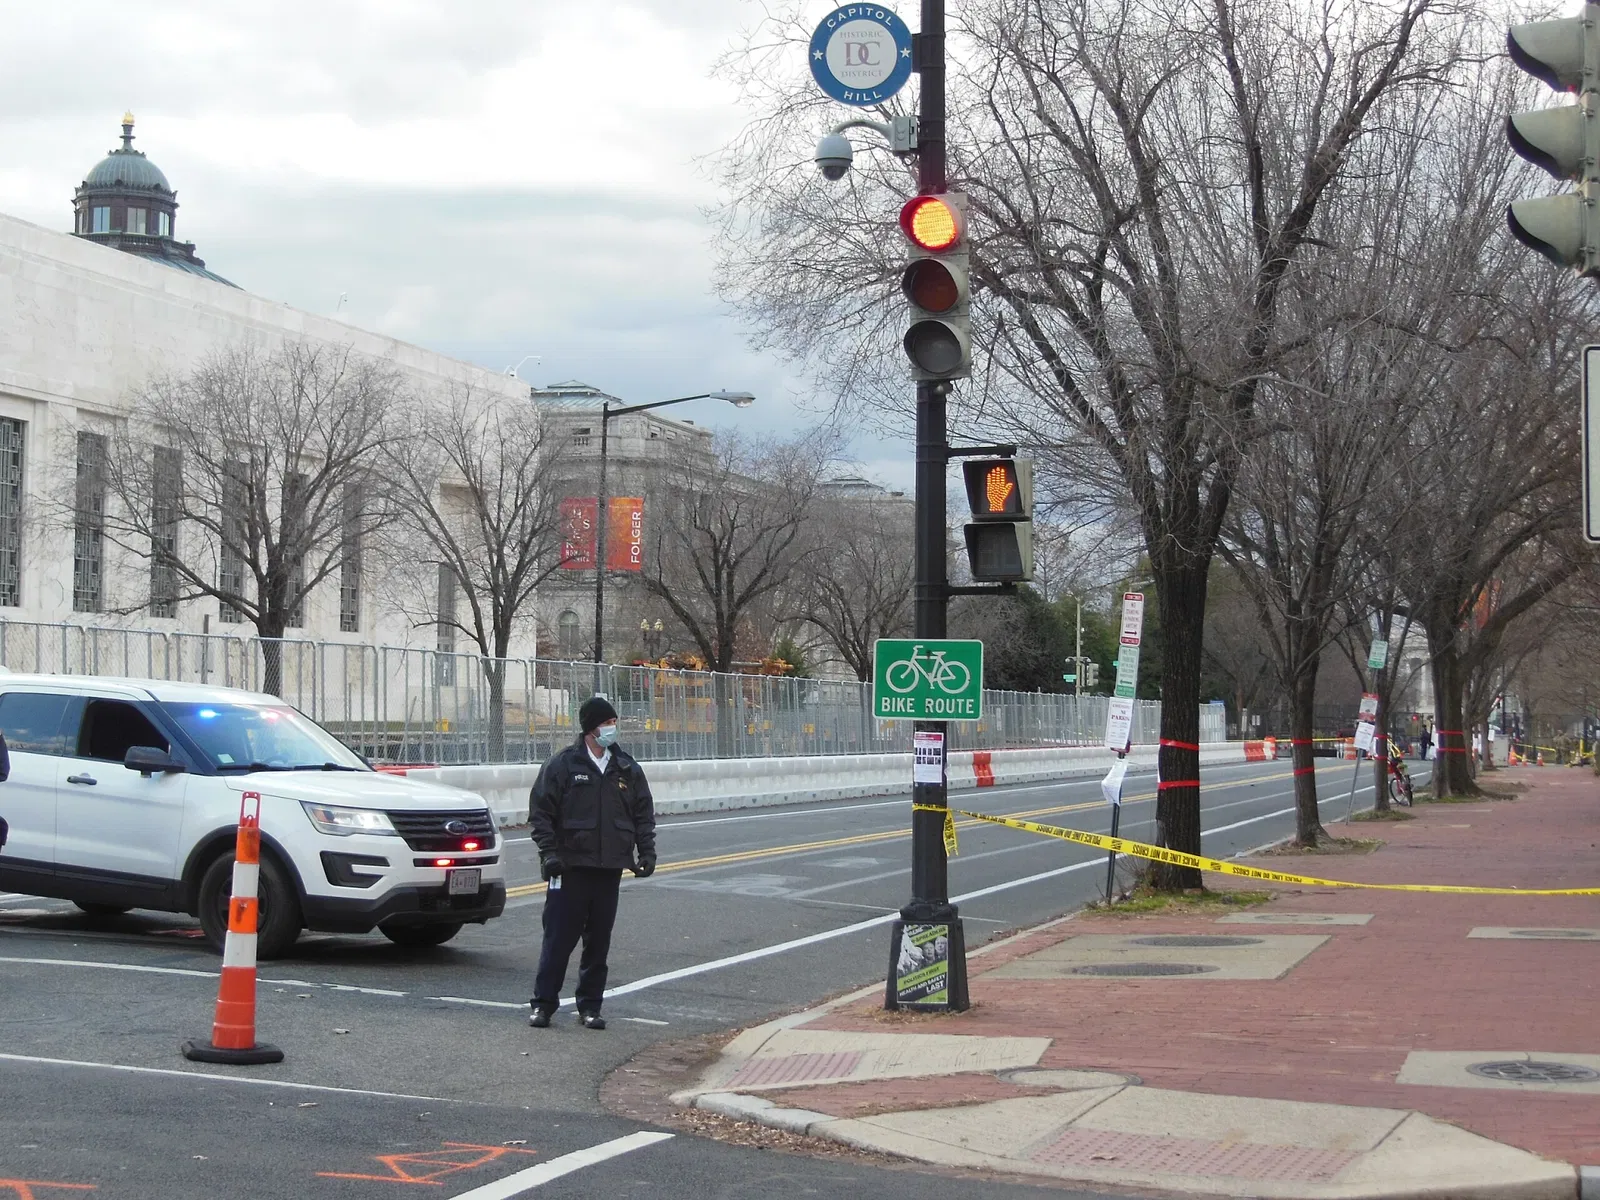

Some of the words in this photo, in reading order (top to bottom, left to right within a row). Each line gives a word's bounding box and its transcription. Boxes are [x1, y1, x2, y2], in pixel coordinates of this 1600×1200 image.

[827, 7, 891, 29] CAPITOL
[840, 30, 884, 39] HISTORIC
[844, 41, 881, 67] DC
[841, 69, 882, 78] DISTRICT
[843, 90, 882, 101] HILL
[631, 511, 641, 564] FOLGER
[881, 697, 915, 713] BIKE
[925, 698, 974, 714] ROUTE
[1132, 843, 1150, 857] CROSS
[1150, 849, 1161, 859] NOT
[1161, 850, 1169, 860] DO
[1169, 852, 1182, 863] LINE
[1182, 855, 1200, 867] POLICE
[1232, 866, 1250, 876] CROSS
[1251, 870, 1262, 878] NOT
[1271, 873, 1284, 881] LINE
[917, 980, 928, 990] AND
[926, 980, 944, 994] LAST
